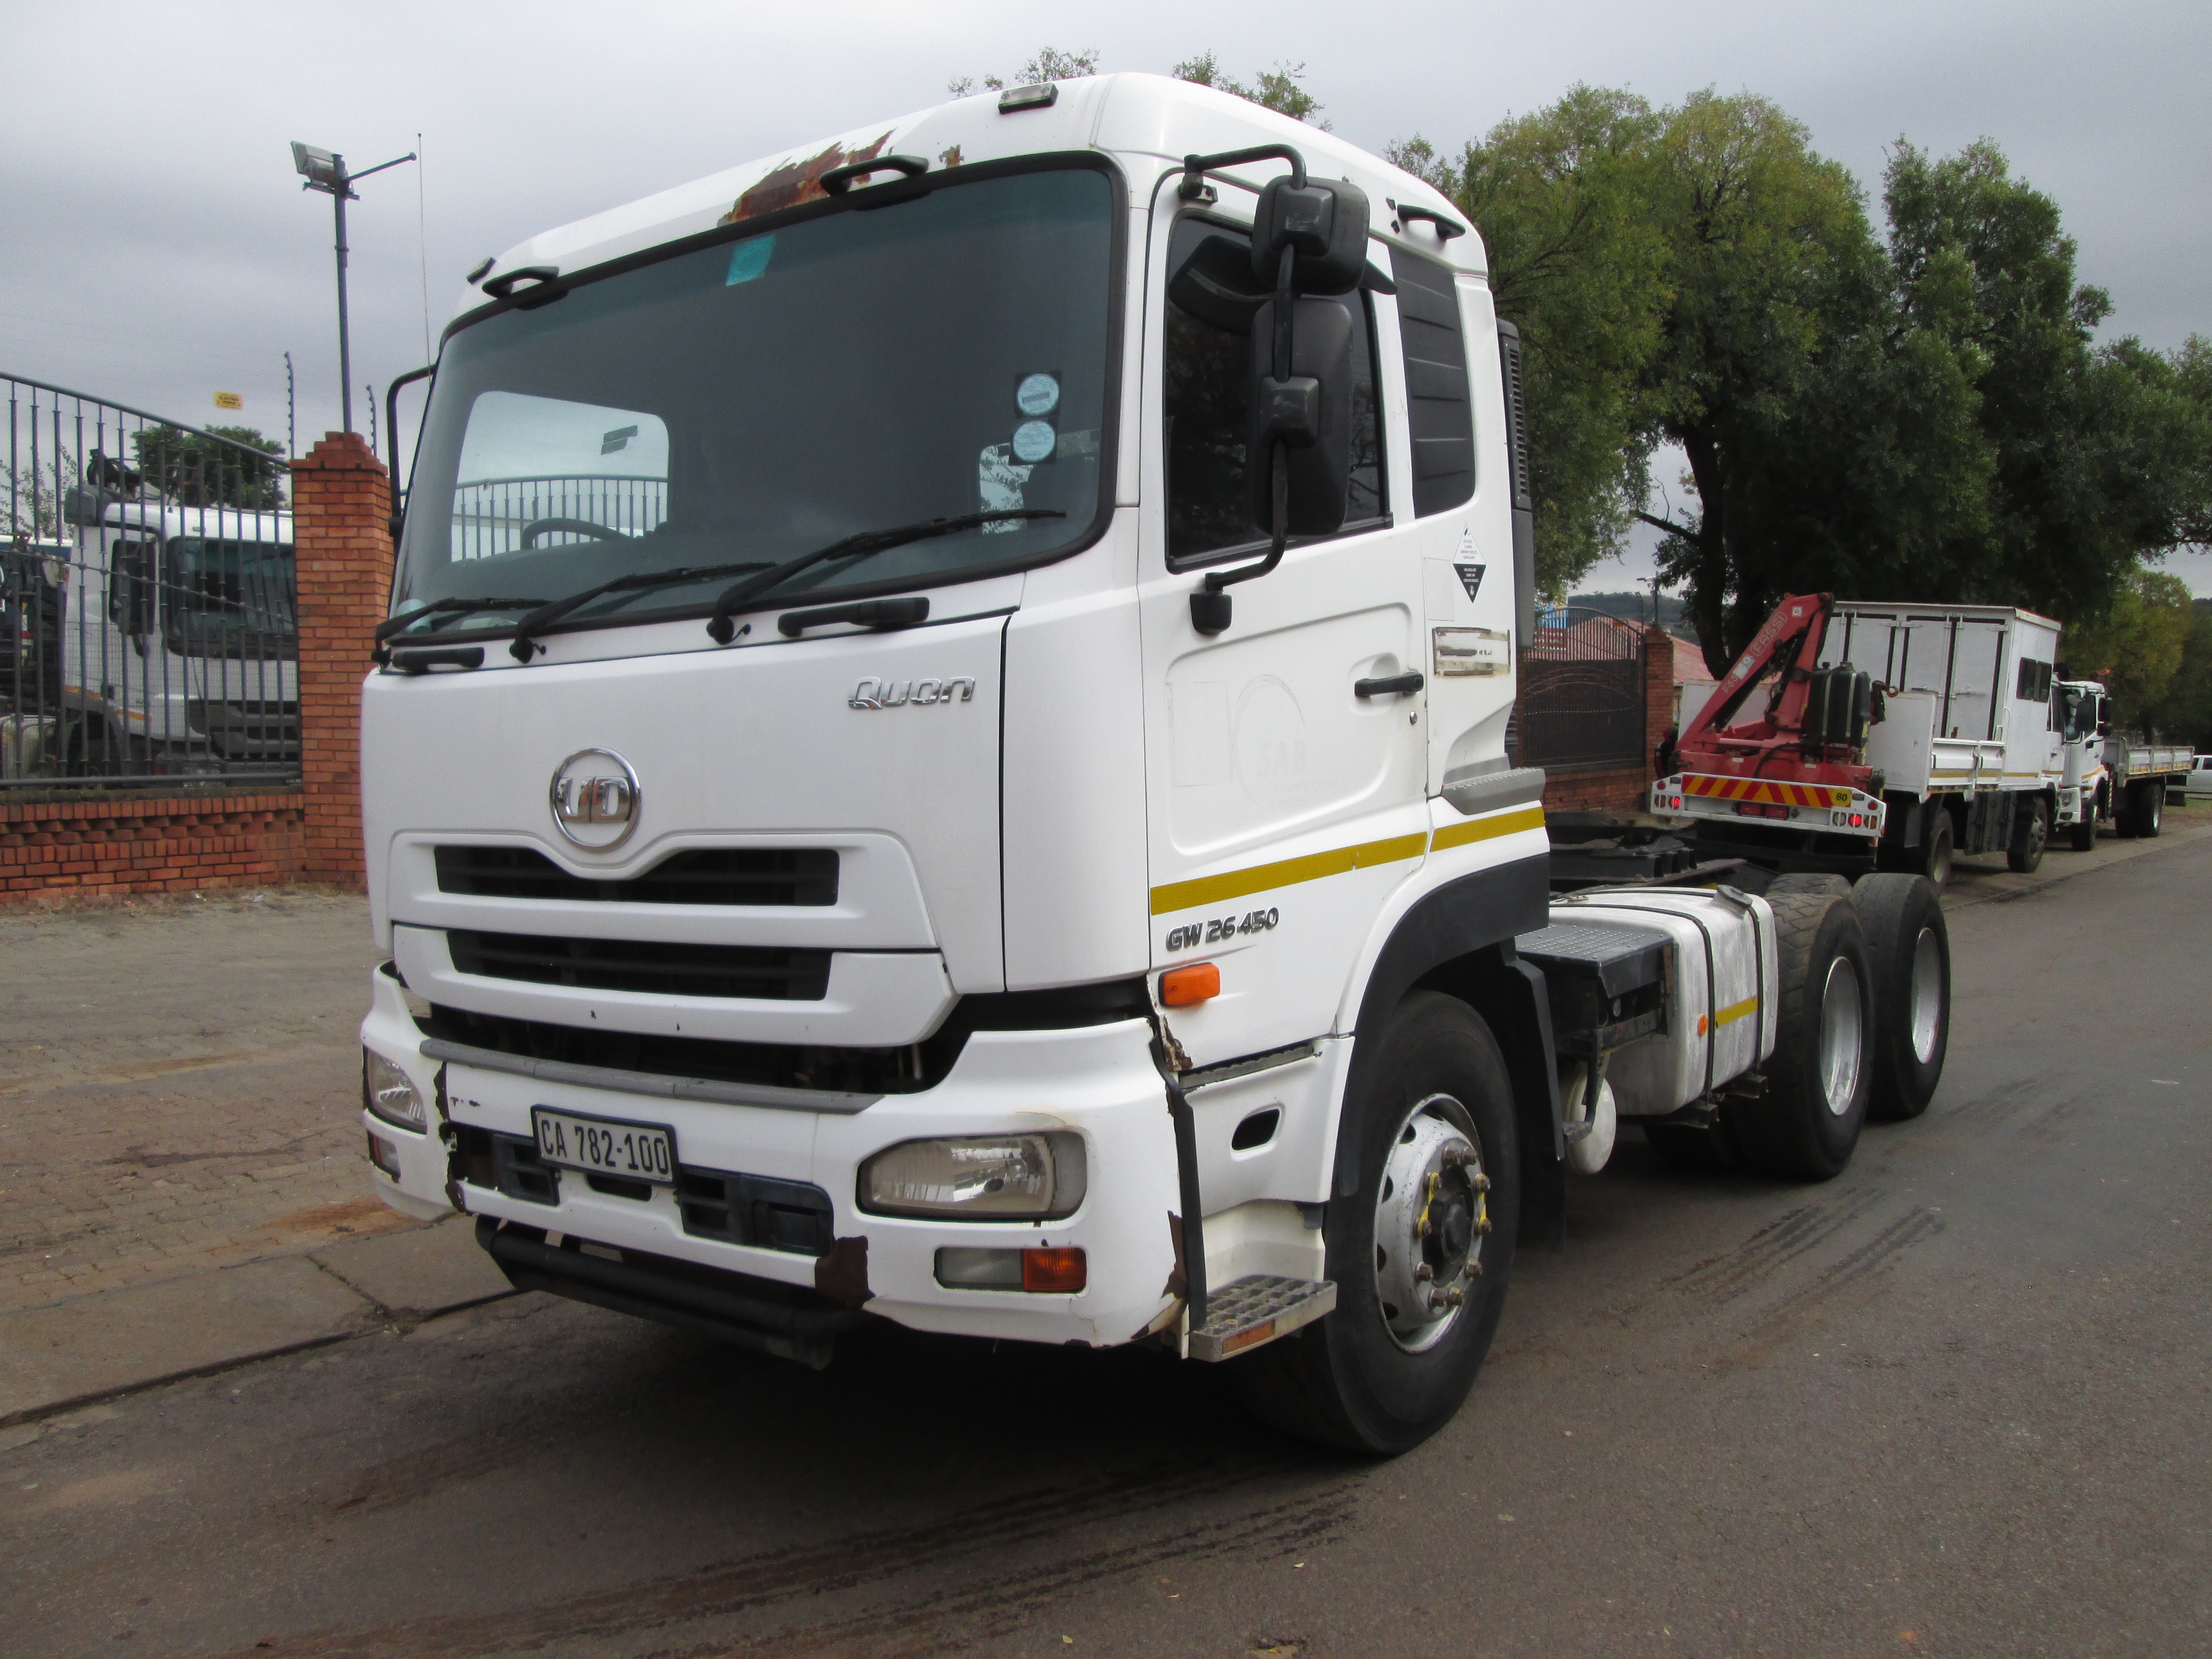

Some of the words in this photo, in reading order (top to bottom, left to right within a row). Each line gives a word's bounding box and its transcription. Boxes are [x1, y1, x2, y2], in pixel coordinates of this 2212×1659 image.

[1754, 615, 1785, 653] FASSI
[848, 676, 975, 709] Quon
[555, 776, 631, 823] UD
[1836, 793, 1847, 801] 80
[1166, 921, 1202, 951] GW
[1206, 914, 1236, 943] 26
[1238, 907, 1279, 935] 450
[541, 1119, 567, 1158] CA
